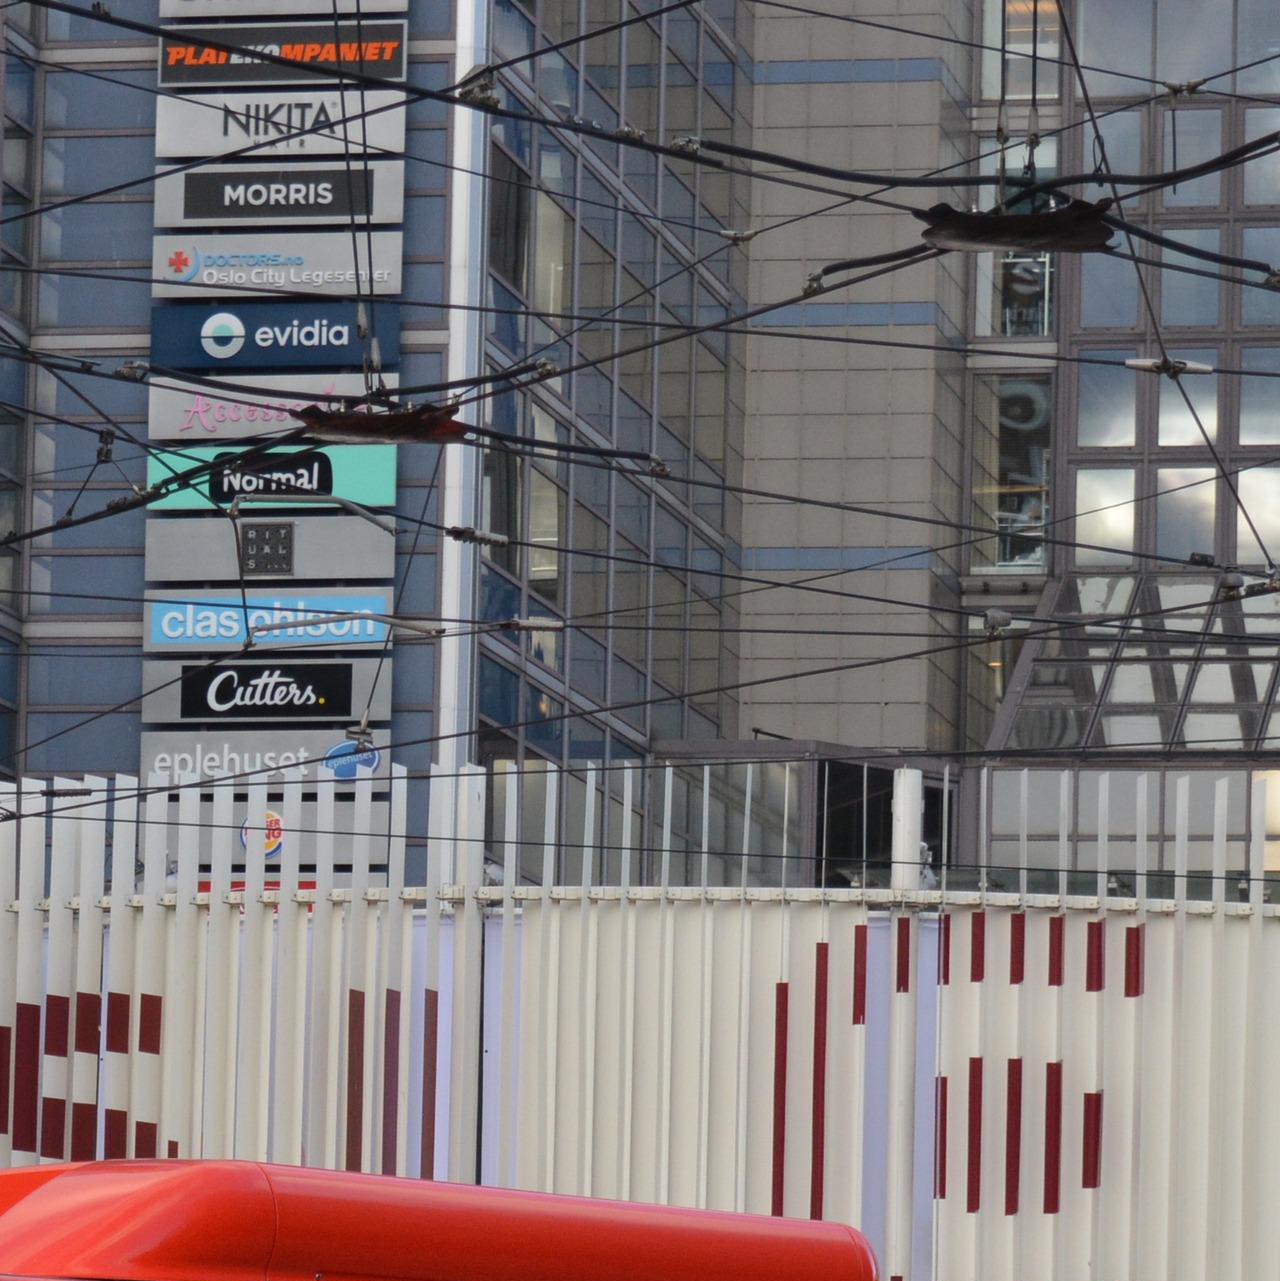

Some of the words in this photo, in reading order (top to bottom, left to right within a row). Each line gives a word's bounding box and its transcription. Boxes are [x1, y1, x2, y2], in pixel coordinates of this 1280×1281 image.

[223, 101, 336, 137] NIKITA
[224, 183, 333, 206] MORRIS
[204, 253, 305, 268] DOCTORS.no
[203, 268, 247, 285] Oslo
[251, 268, 285, 287] City
[290, 268, 391, 287] Legesener
[255, 320, 350, 348] evidia
[223, 462, 320, 493] Normal
[161, 602, 240, 639] clas
[248, 602, 375, 638] ohlson
[154, 744, 309, 785] eplehuset
